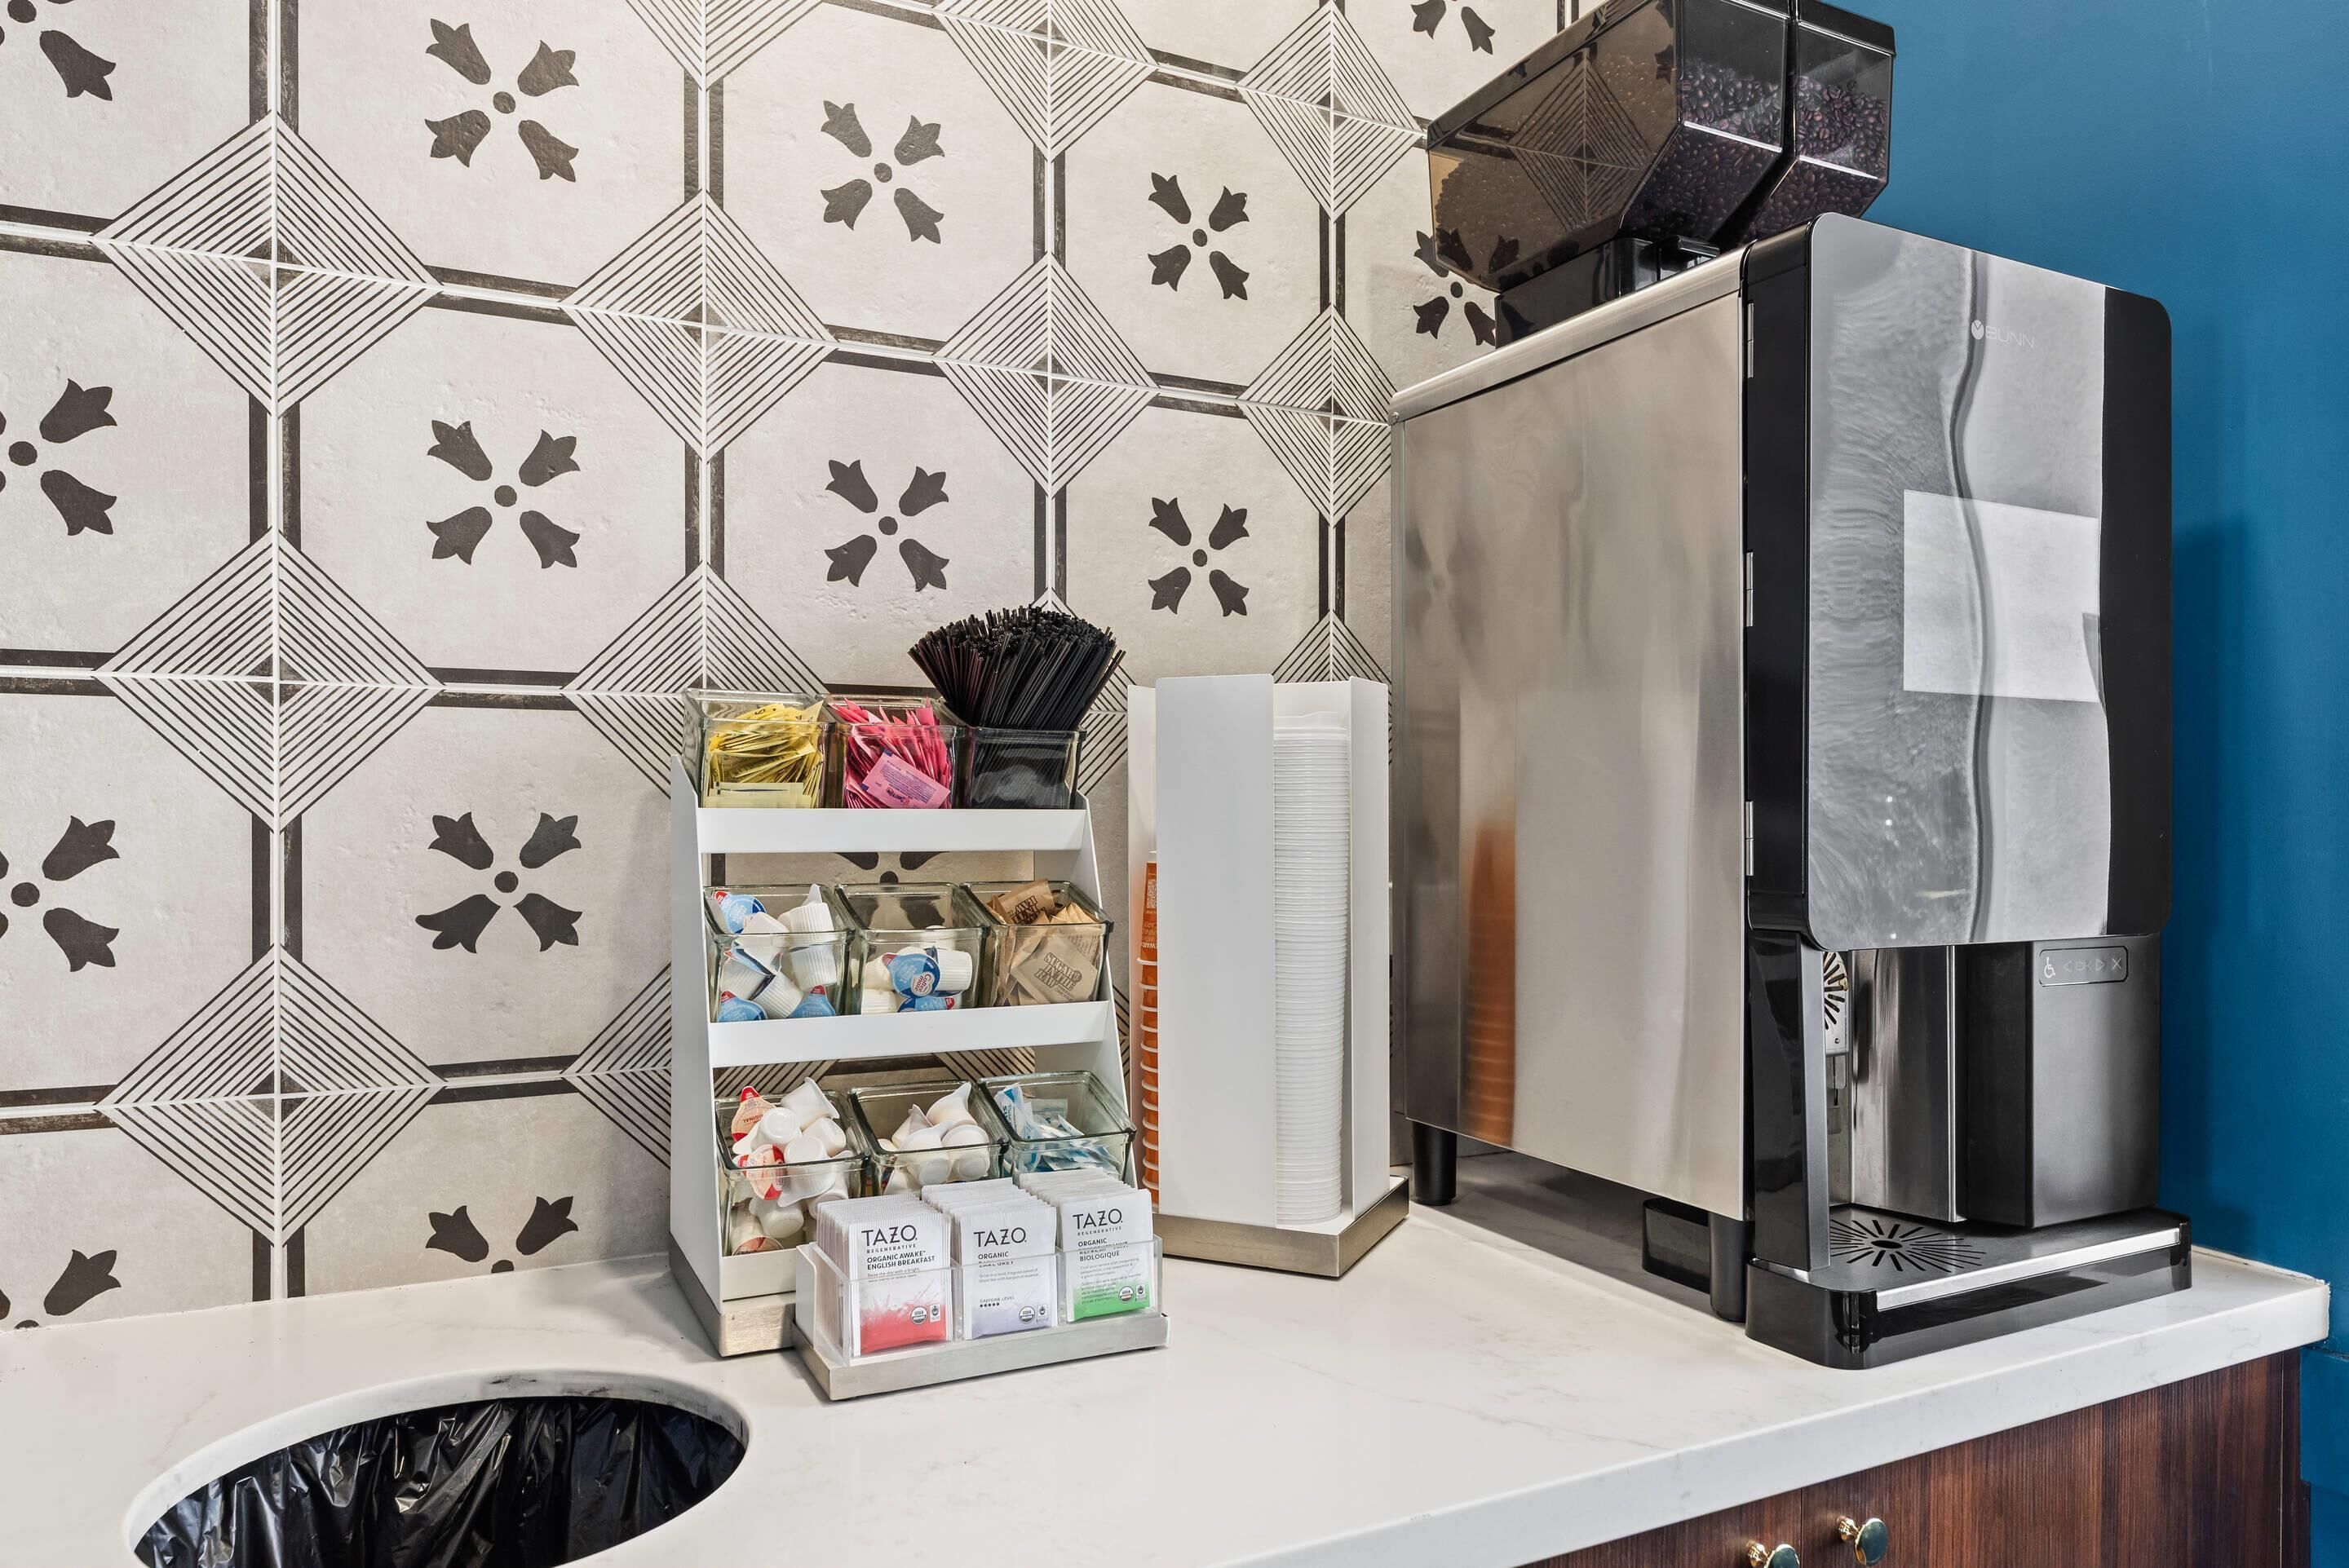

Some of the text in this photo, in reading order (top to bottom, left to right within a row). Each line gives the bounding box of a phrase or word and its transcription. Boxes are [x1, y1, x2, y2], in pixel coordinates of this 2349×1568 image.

[1985, 325, 2034, 349] BUNN
[1044, 952, 1076, 982] SUGAR
[914, 975, 924, 992] mate
[918, 974, 932, 992] Coffee
[1034, 968, 1059, 988] RAW
[1055, 971, 1076, 992] THE
[1073, 1208, 1122, 1230] TAZO
[861, 1225, 917, 1247] TAZO
[973, 1227, 1027, 1248] TAZO
[1077, 1226, 1121, 1236] REGENERATIVE
[866, 1243, 916, 1254] REGENERATIVE
[1077, 1238, 1107, 1248] ORGANIC
[867, 1254, 898, 1264] ORGANIC
[867, 1256, 936, 1270] ENGLISH BREAKFAST
[978, 1251, 1009, 1260] ORGANIC
[1080, 1250, 1121, 1262] BIOLOGIQUE
